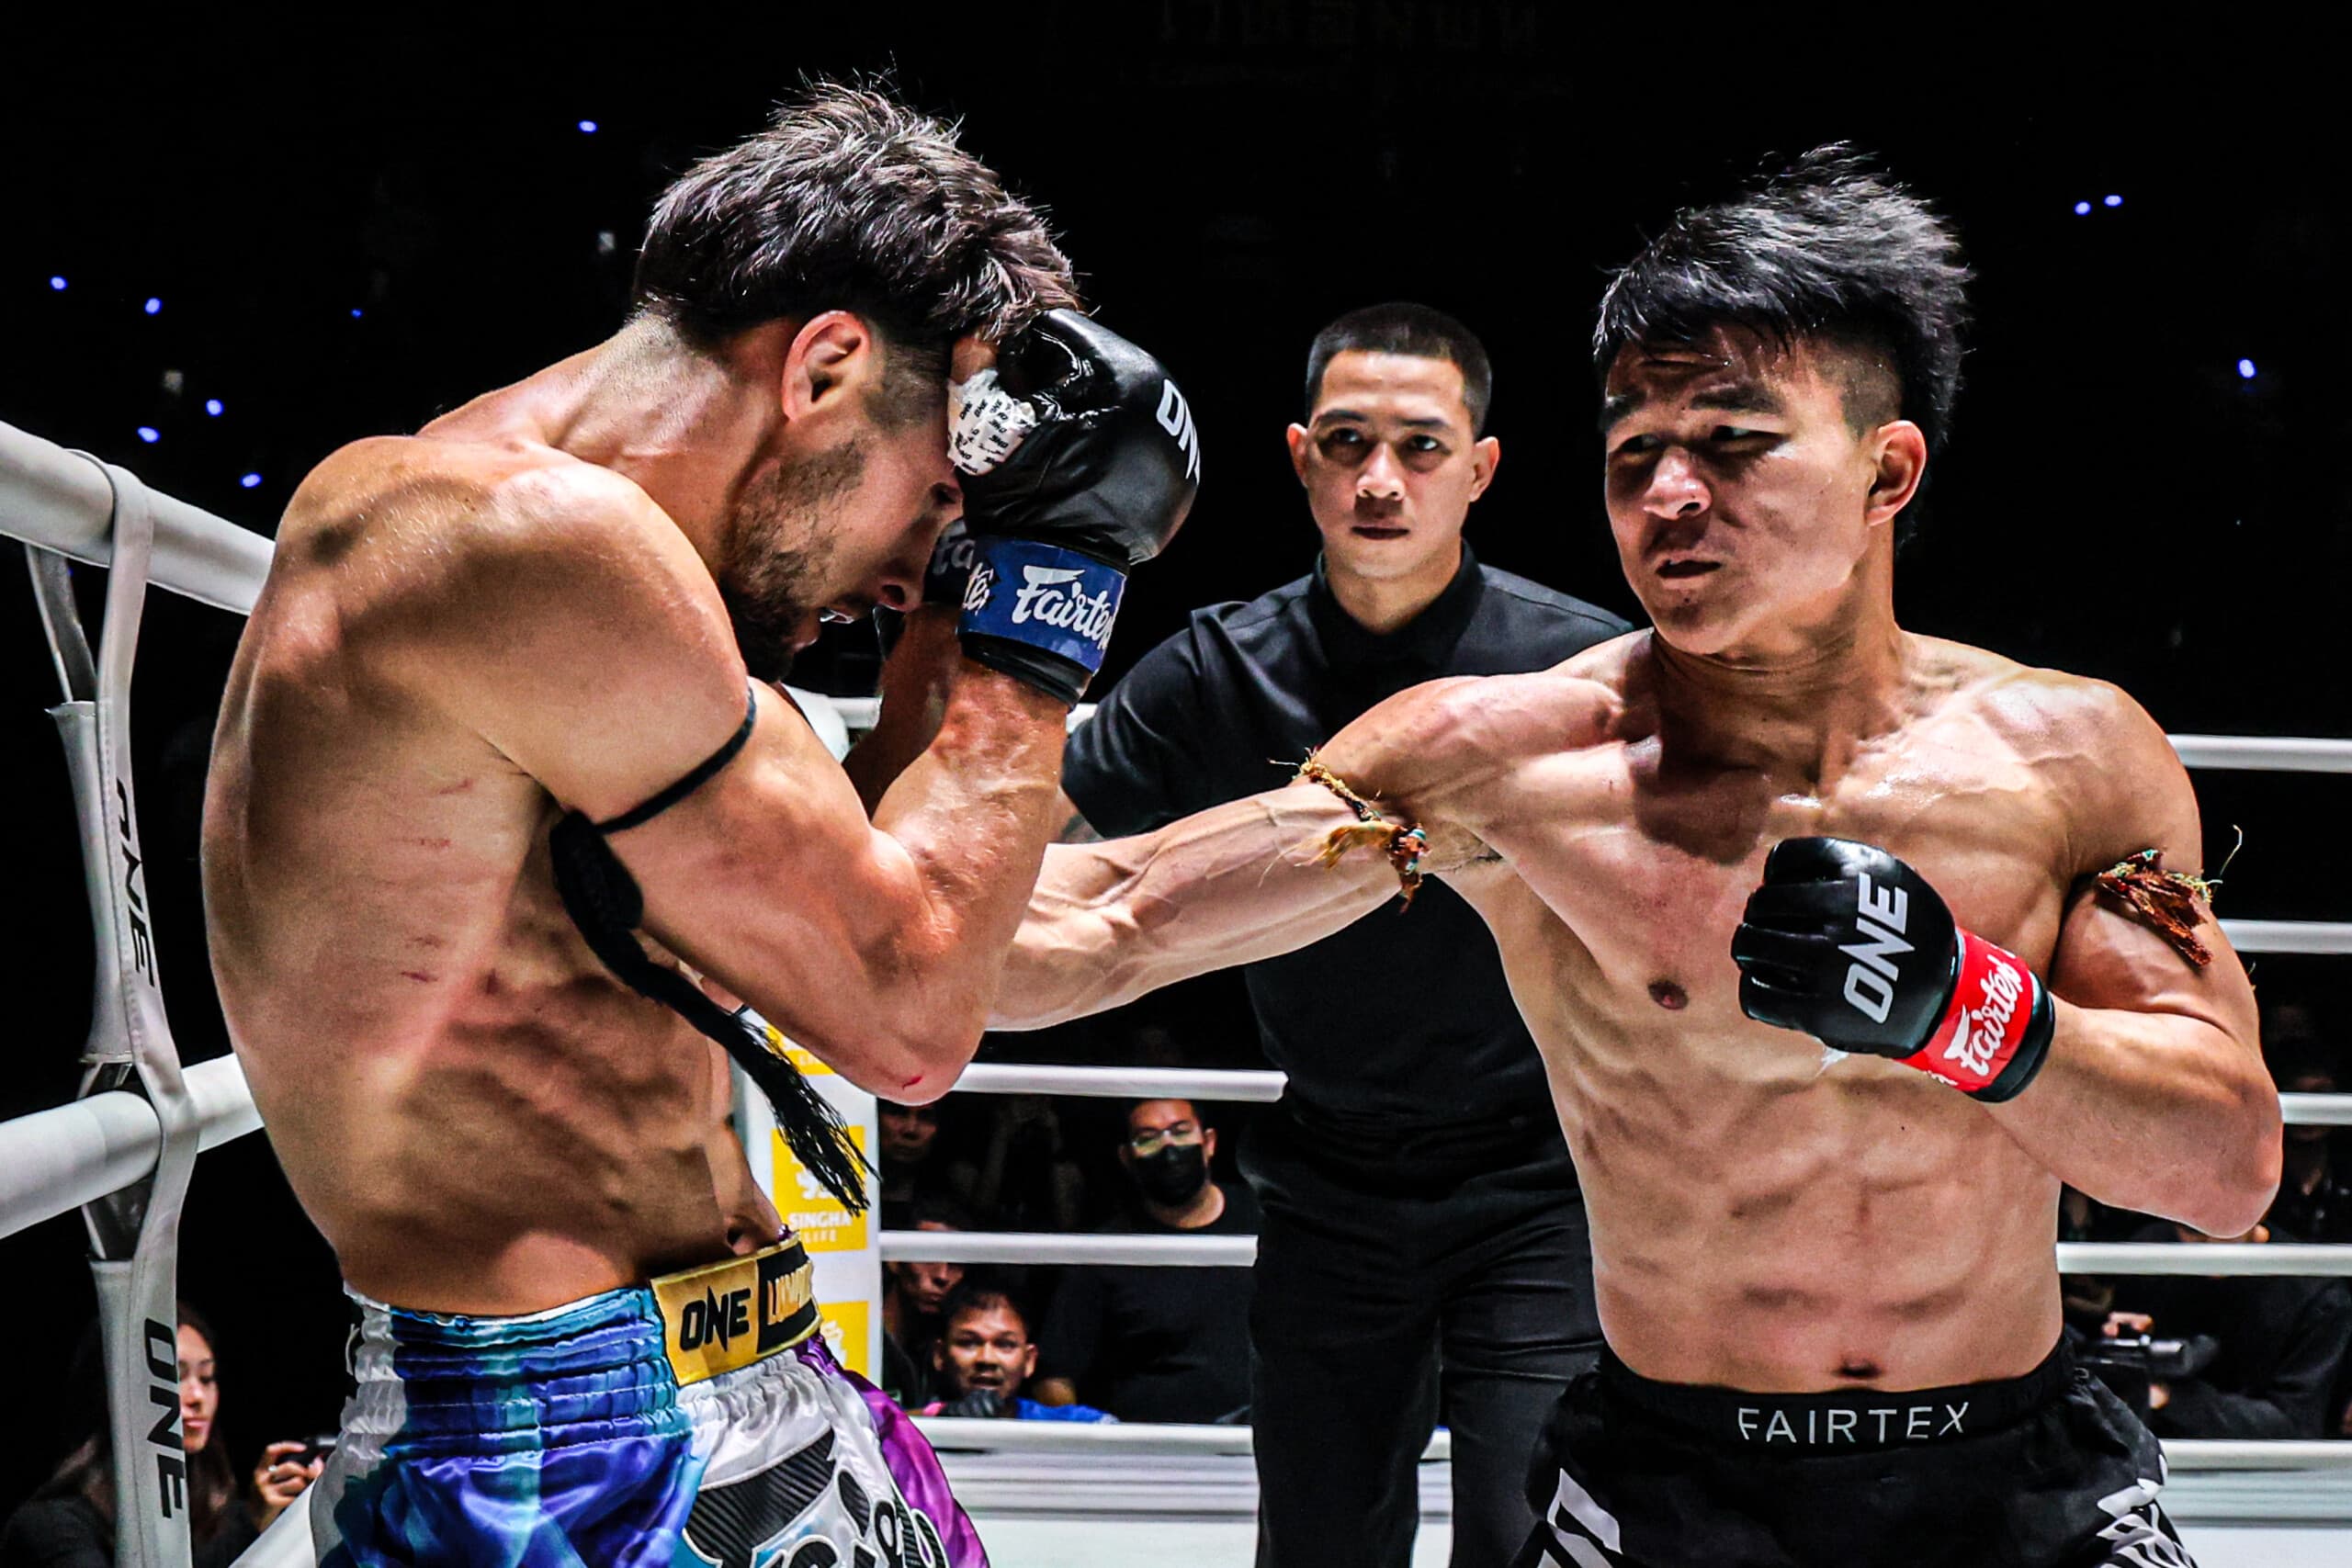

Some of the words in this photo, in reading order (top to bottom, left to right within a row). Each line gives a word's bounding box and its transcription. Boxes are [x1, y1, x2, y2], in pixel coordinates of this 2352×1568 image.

[1156, 378, 1200, 485] ON
[1838, 872, 1917, 1024] ONE
[1943, 953, 2024, 1077] Fairtex
[788, 1211, 853, 1229] SINGHA
[680, 1287, 752, 1352] ONE
[144, 1318, 186, 1518] ONE
[1738, 1402, 1970, 1442] FAIRTEX
